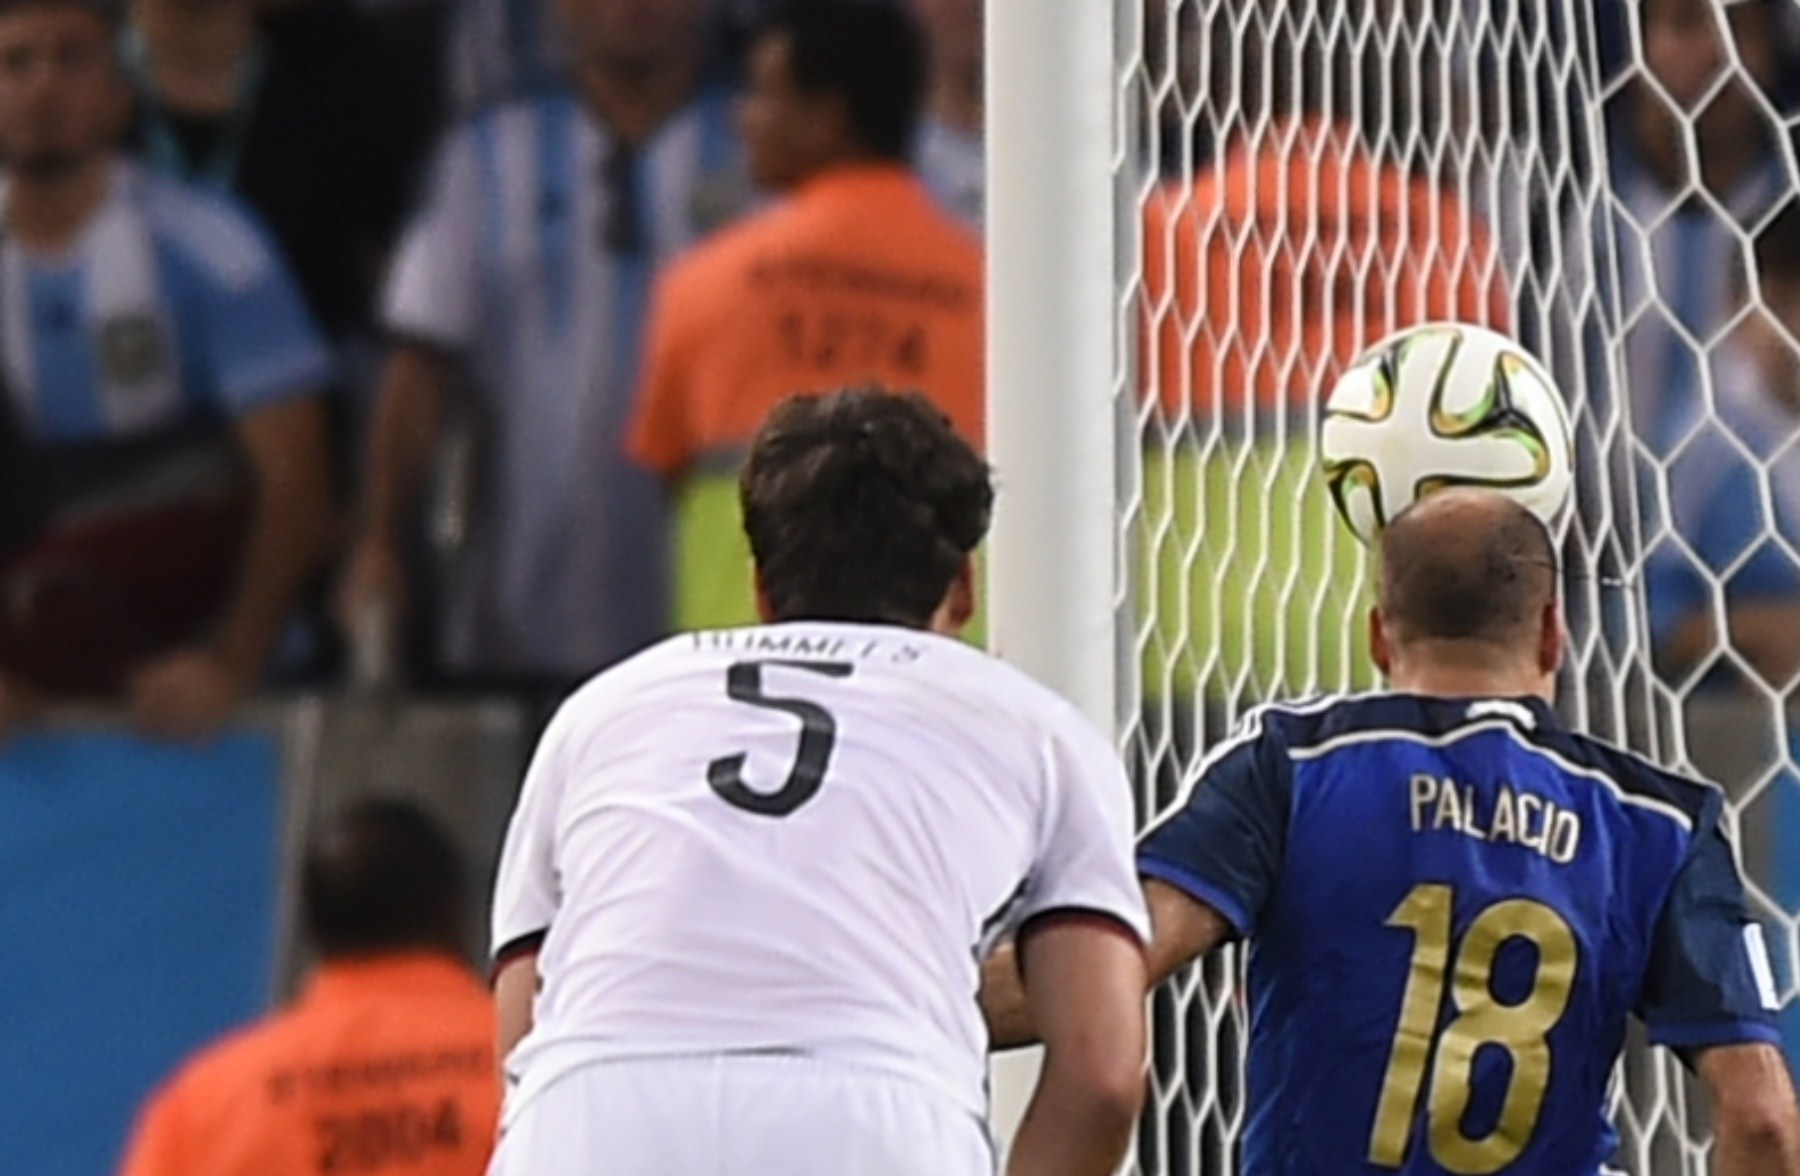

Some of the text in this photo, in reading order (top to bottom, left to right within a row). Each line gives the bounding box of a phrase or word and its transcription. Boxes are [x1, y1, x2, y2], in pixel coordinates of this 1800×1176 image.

[706, 659, 855, 818] 5
[1409, 773, 1581, 865] PALACIO
[1366, 882, 1579, 1176] 18
